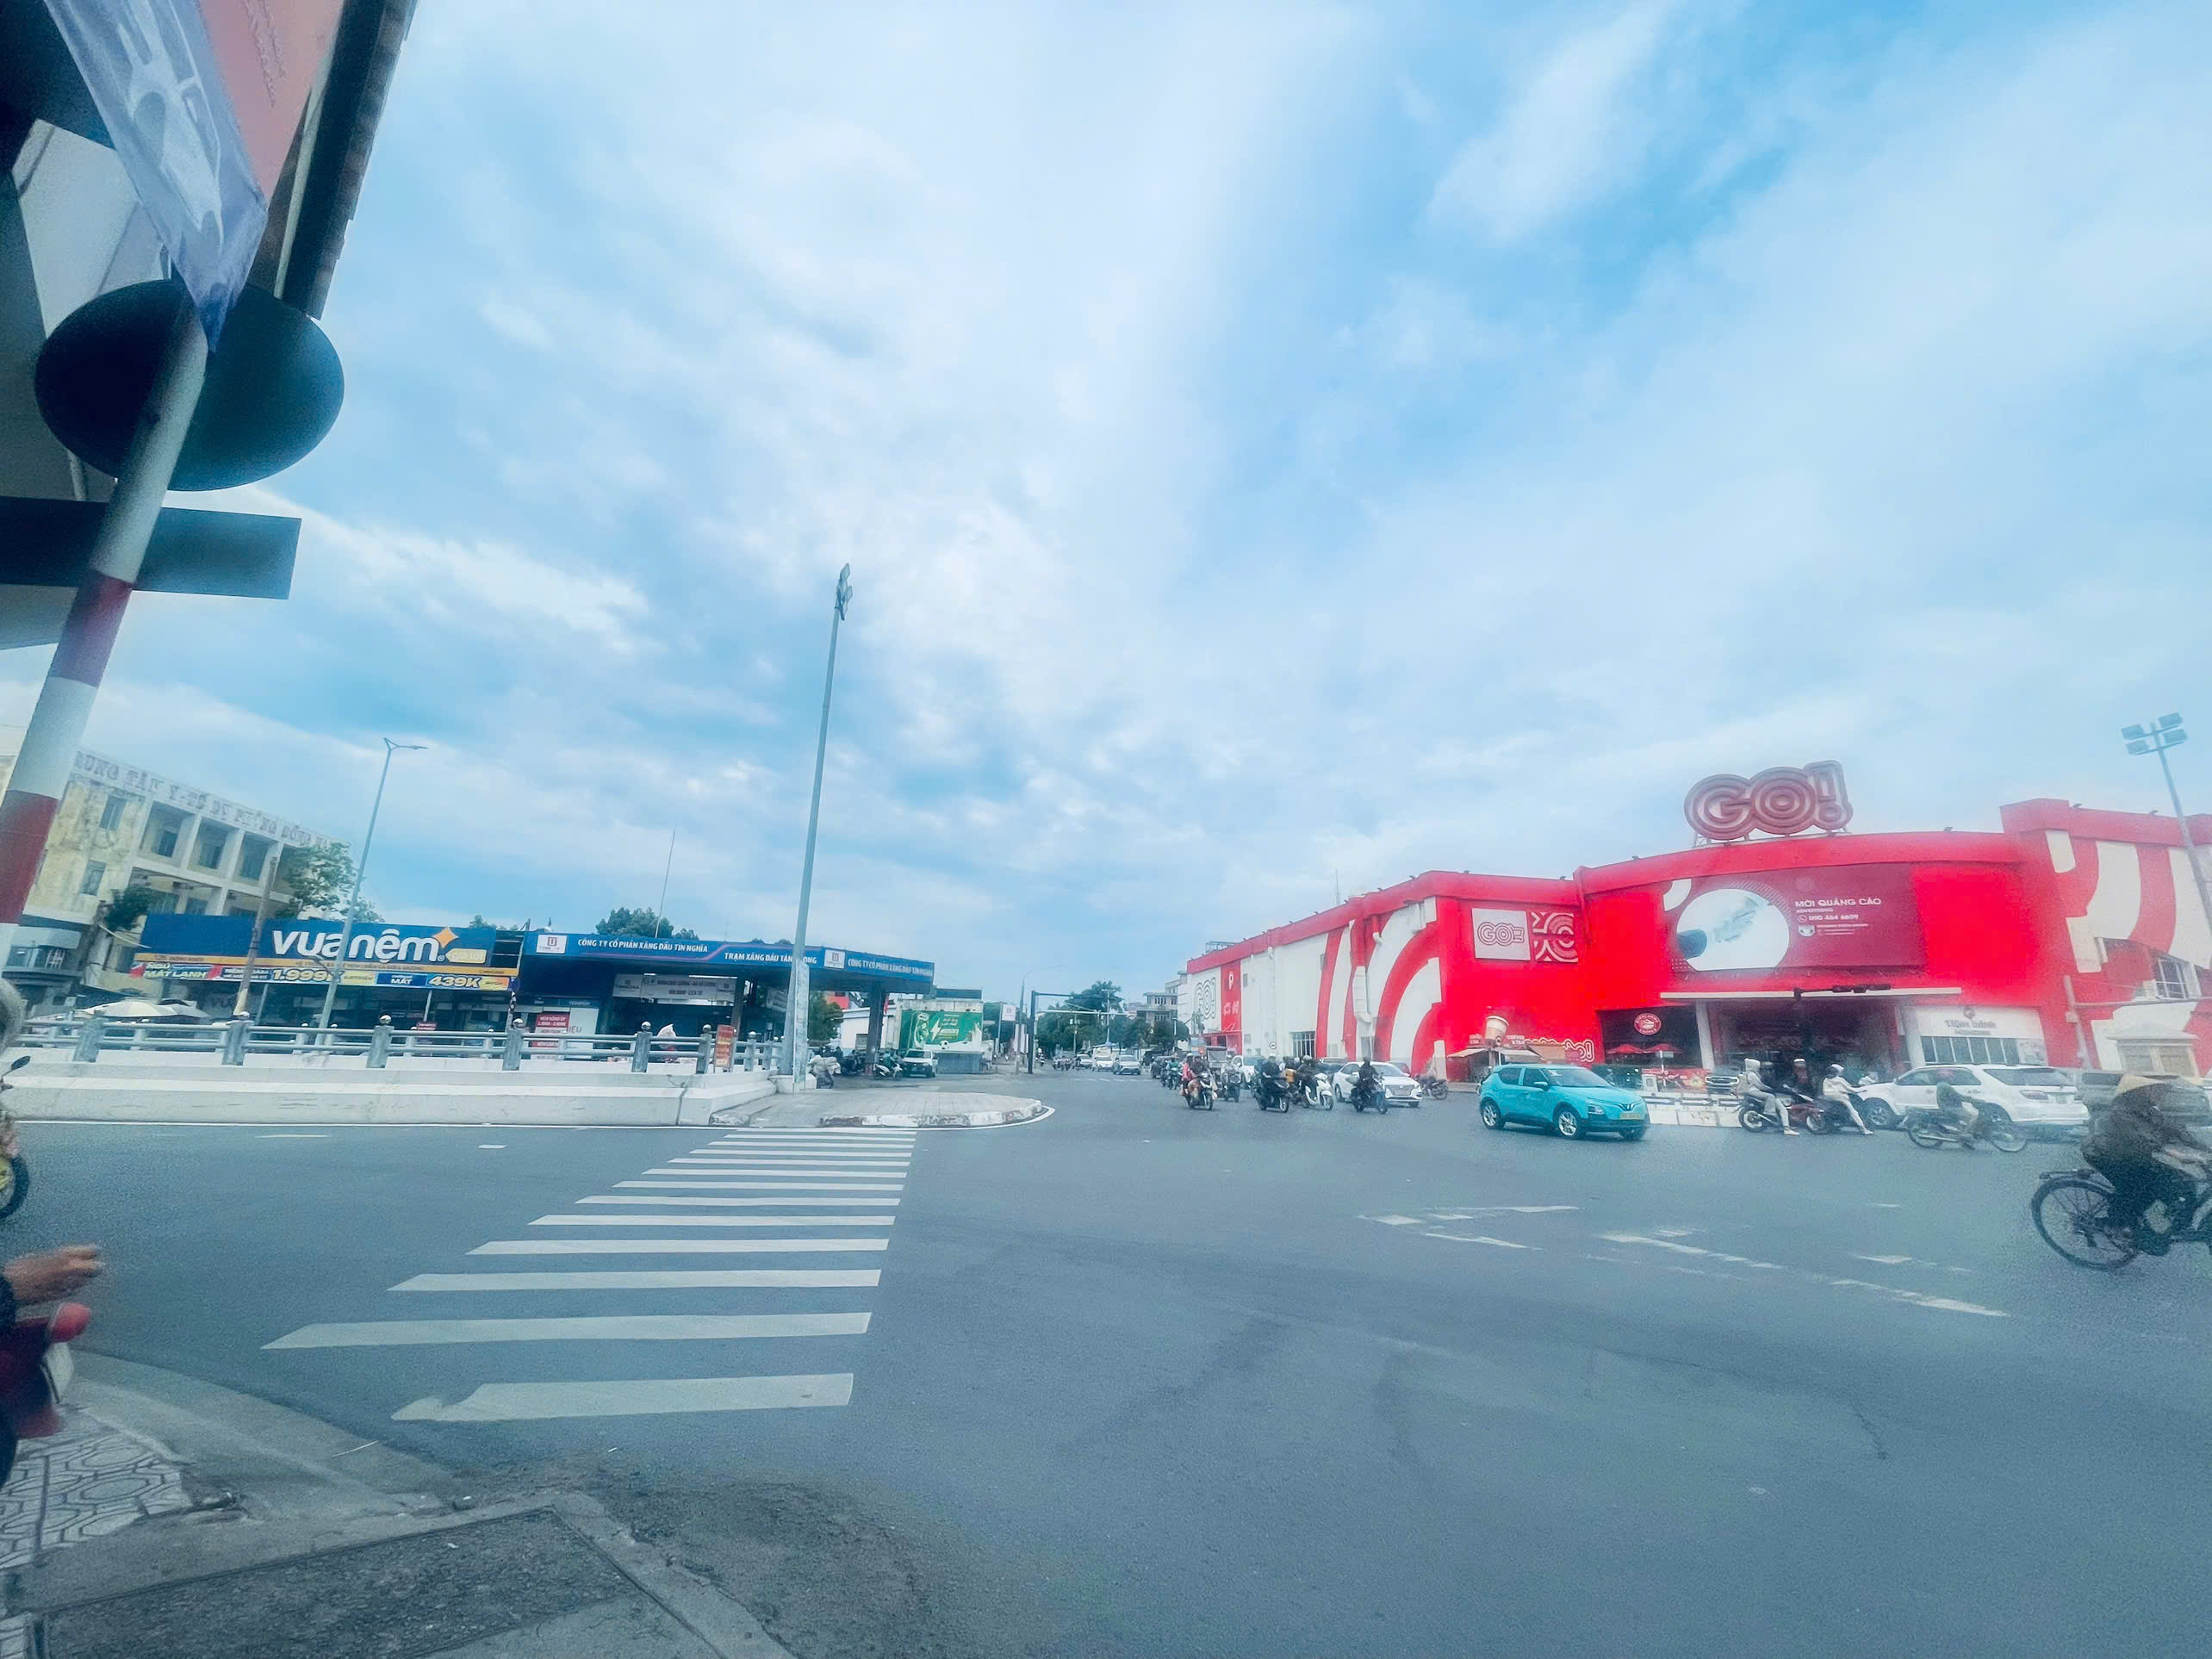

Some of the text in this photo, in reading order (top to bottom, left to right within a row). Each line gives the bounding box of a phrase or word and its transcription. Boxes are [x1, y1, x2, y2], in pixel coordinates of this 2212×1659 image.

[1684, 760, 1853, 840] GO!
[577, 938, 598, 947] CÔNG
[724, 951, 746, 962] TRẠM
[428, 975, 482, 988] 439K
